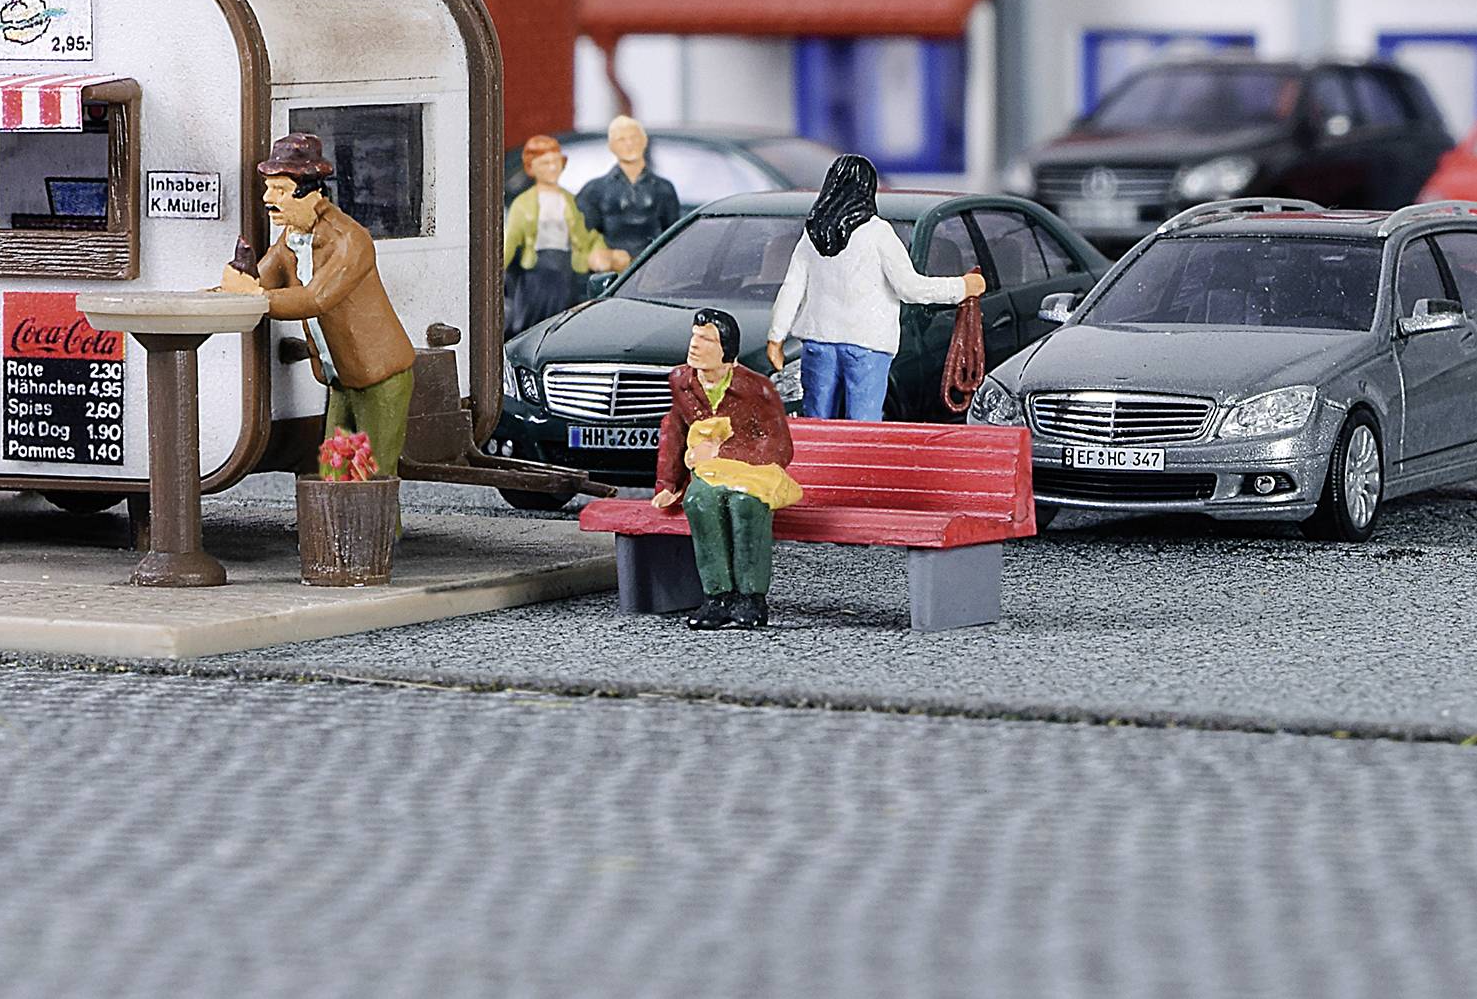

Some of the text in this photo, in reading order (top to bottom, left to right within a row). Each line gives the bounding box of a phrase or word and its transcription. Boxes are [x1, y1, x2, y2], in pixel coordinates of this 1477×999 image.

[151, 177, 216, 192] Inhaber:
[7, 361, 44, 377] Rote
[7, 379, 86, 395] Hähnchen
[8, 399, 52, 417] Spies
[7, 419, 34, 436] Hot
[38, 421, 70, 440] Dog
[8, 440, 75, 459] Pommes
